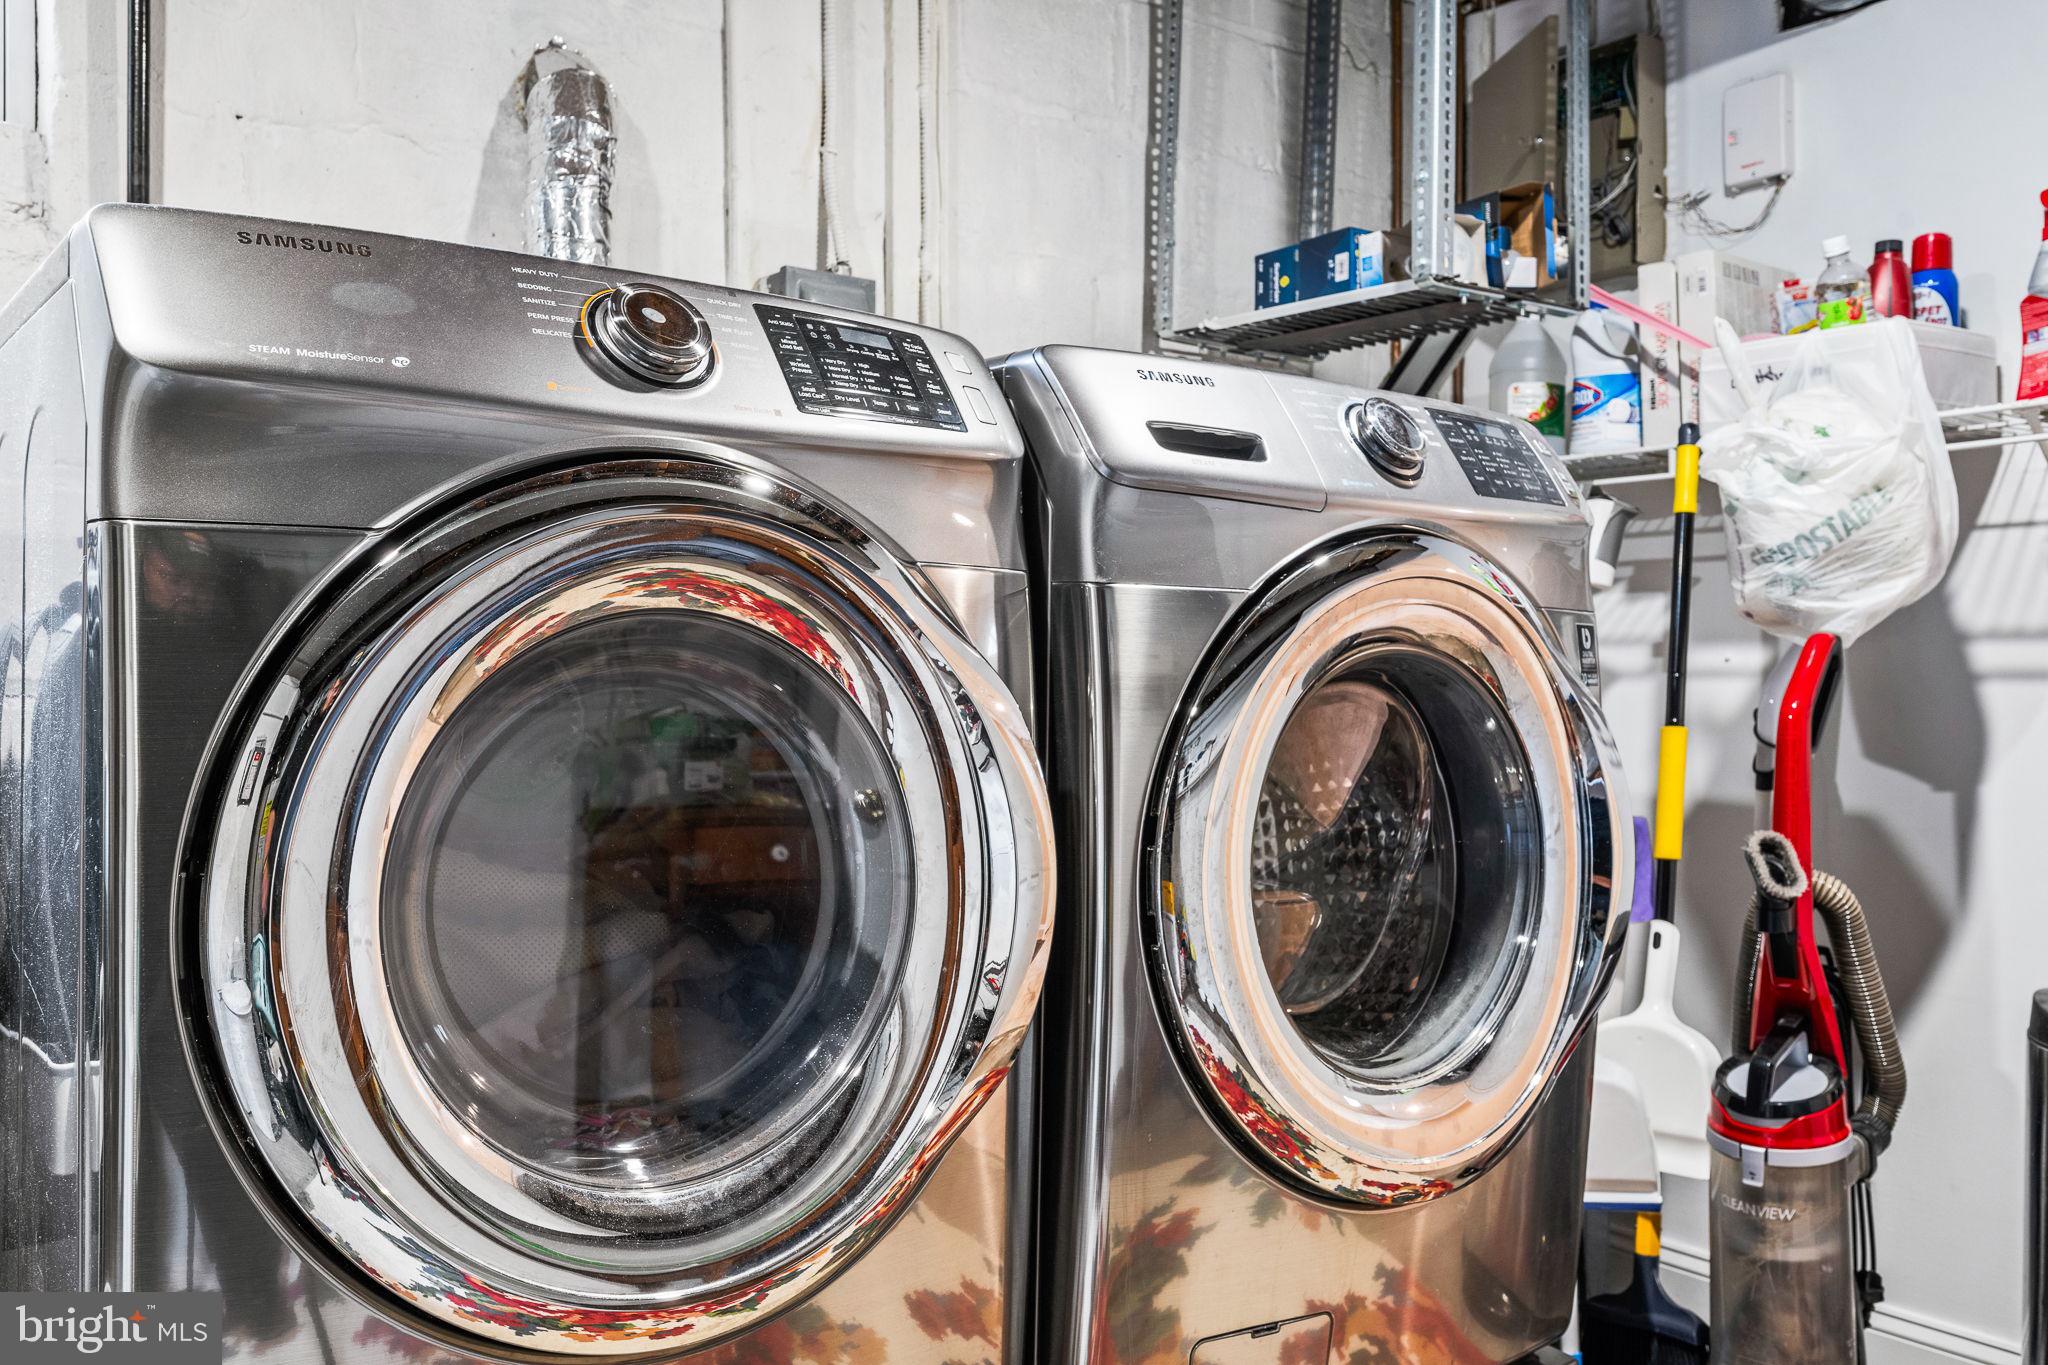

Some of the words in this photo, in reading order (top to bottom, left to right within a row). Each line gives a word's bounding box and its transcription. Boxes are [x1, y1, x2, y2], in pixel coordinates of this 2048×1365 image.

[237, 230, 372, 257] SAMSUNG
[511, 266, 537, 275] HEAVY
[538, 270, 559, 278] DUTY
[517, 282, 552, 292] BEDDING
[522, 296, 557, 307] SANITIZE
[527, 311, 549, 320] PERM
[550, 315, 575, 323] PRESS
[532, 328, 573, 339] DELICATES
[249, 344, 291, 355] STEAM
[296, 348, 385, 364] MoistureSensor
[1136, 369, 1216, 388] SAMSUNG
[1720, 1194, 1798, 1222] CLEANVIEW
